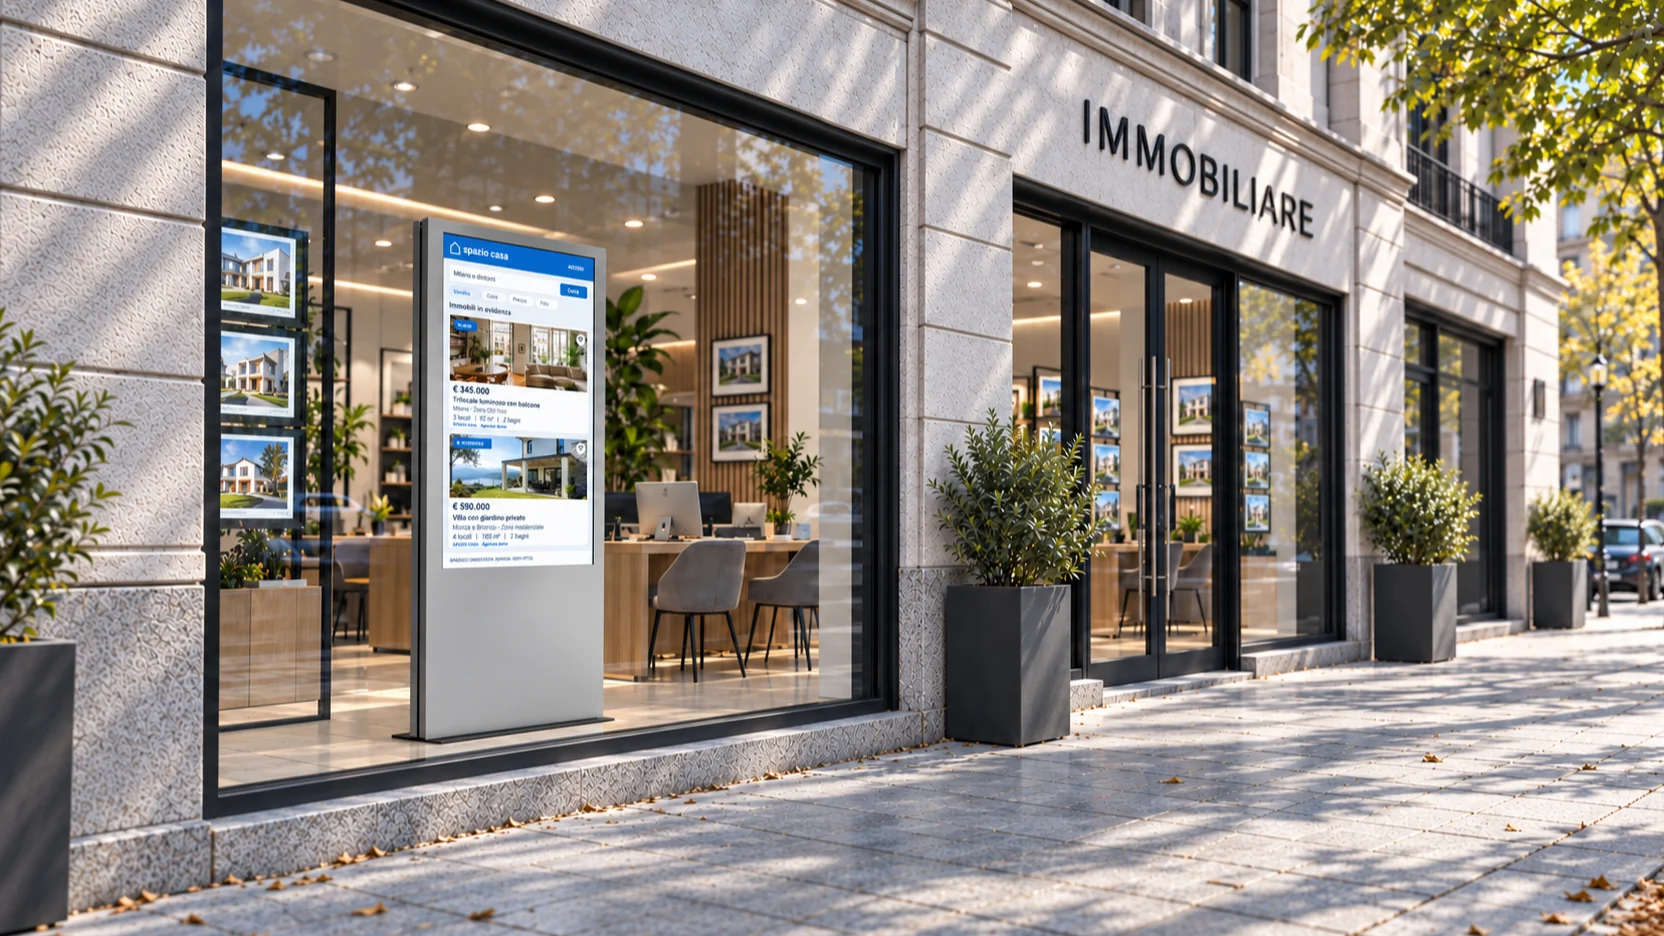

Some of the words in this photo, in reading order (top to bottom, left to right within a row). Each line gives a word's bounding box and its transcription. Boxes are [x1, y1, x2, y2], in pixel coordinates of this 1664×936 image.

[1084, 99, 1314, 238] IMMOBILIARE
[463, 246, 489, 257] spazio
[490, 251, 509, 261] casa
[449, 301, 476, 311] Immobili
[484, 307, 512, 316] evidenza
[452, 385, 458, 393] €
[460, 385, 490, 395] 345.000
[518, 401, 541, 409] balcone
[452, 502, 458, 511] €
[460, 502, 491, 511] 590.000
[480, 514, 505, 522] giardino
[505, 514, 526, 522] privato
